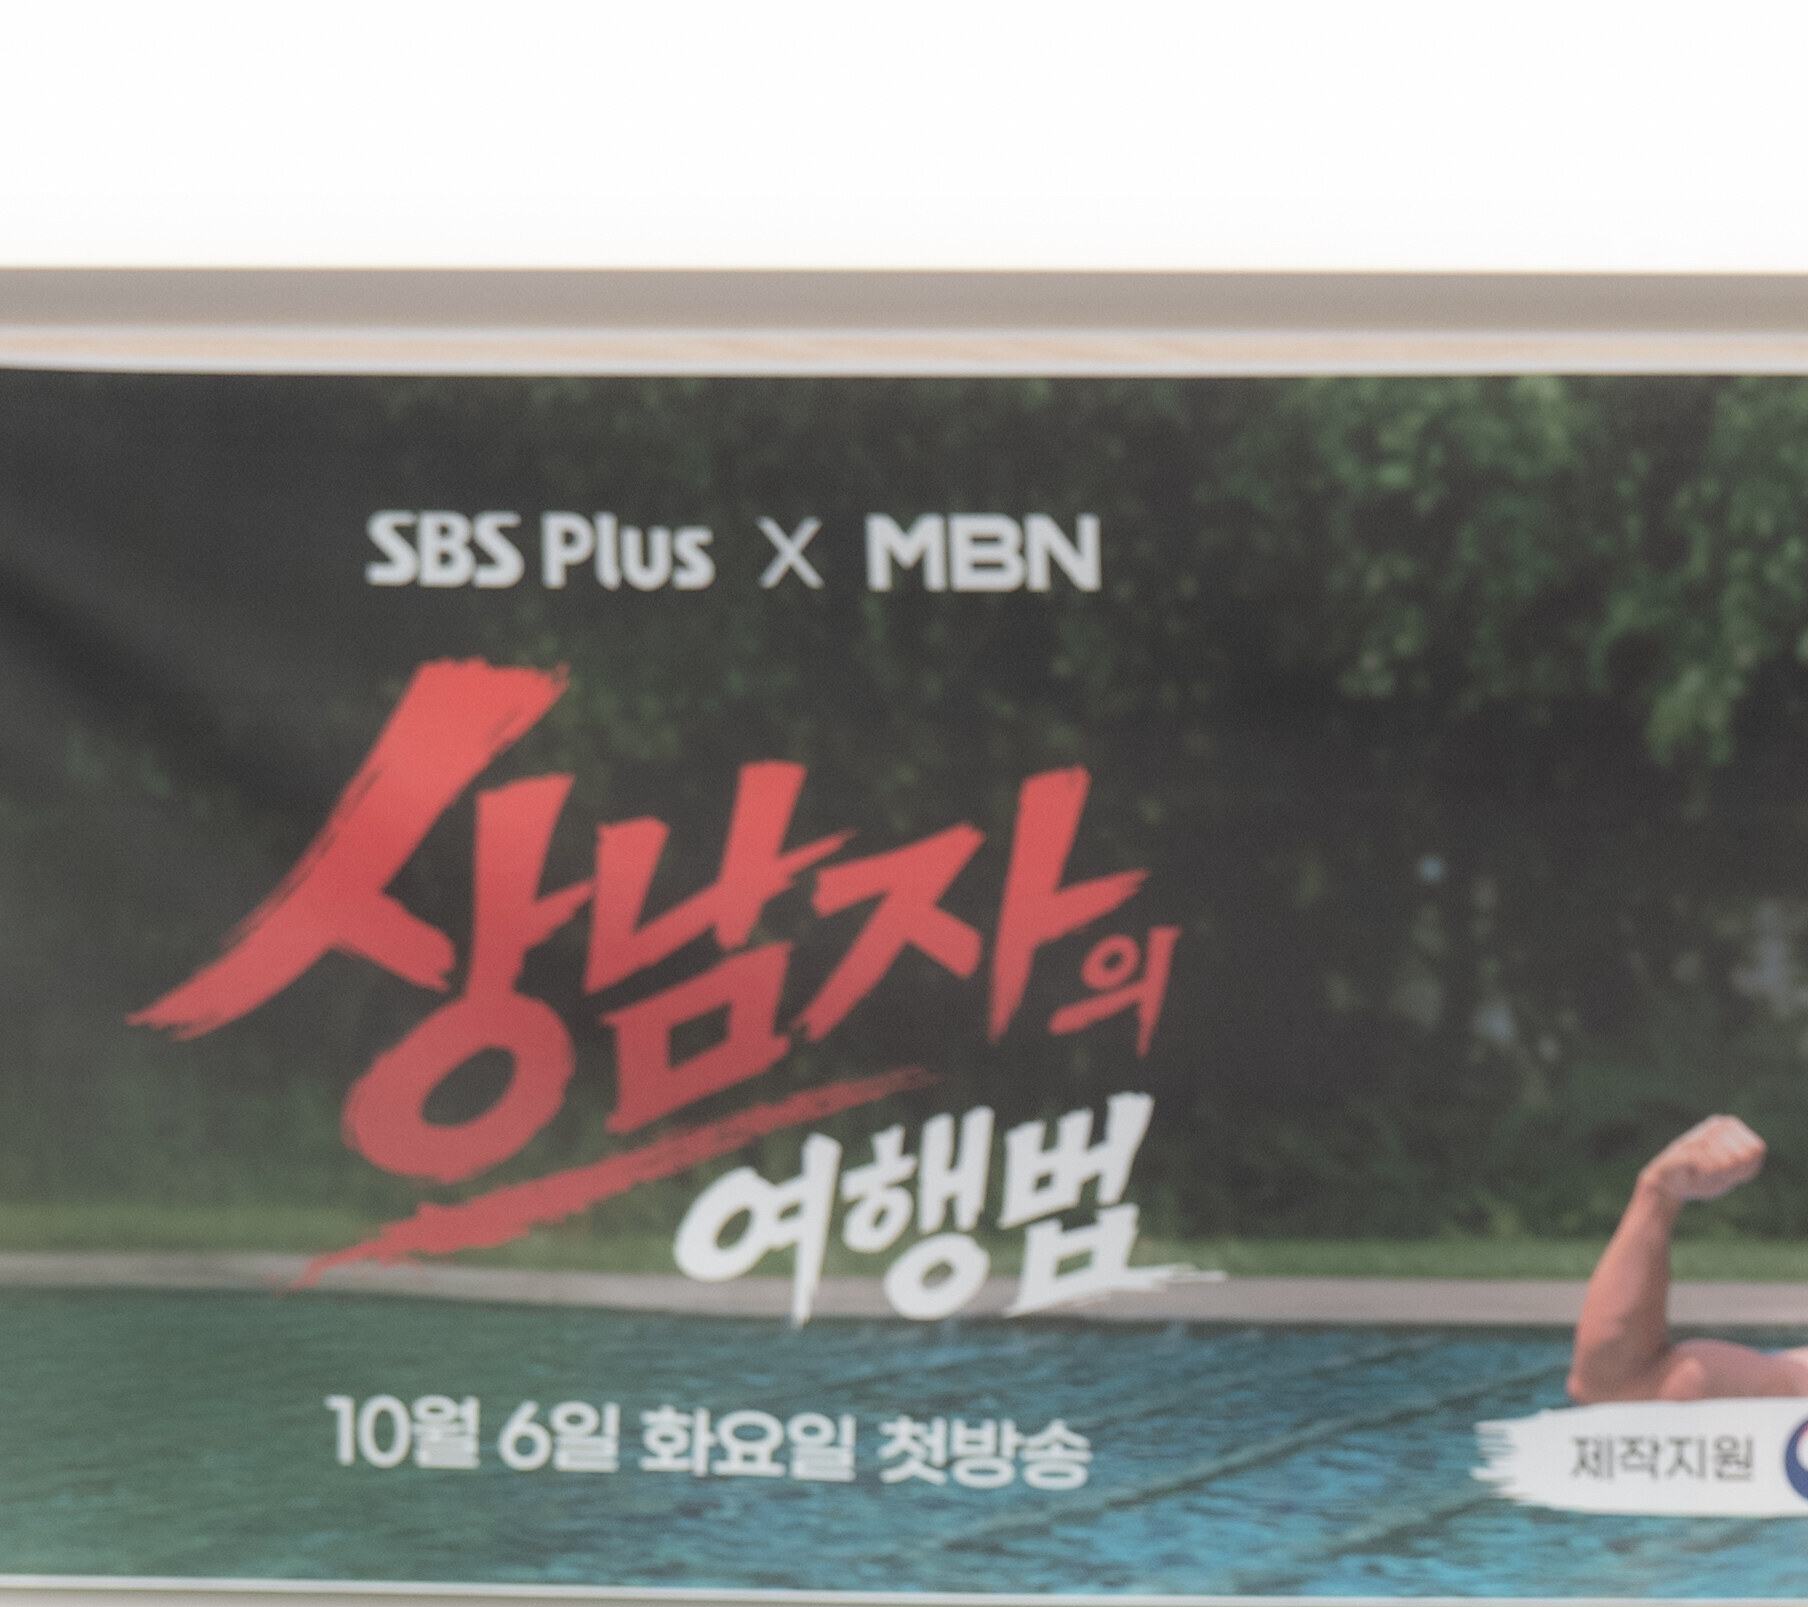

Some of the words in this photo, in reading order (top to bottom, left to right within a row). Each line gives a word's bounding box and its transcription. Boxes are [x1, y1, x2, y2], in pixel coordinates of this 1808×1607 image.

[365, 509, 524, 588] SBS
[541, 511, 715, 591] Plus
[865, 514, 1102, 592] MBN
[125, 656, 1184, 1185] 상남자의
[324, 1395, 481, 1472] 10월
[497, 1400, 622, 1476] 6일
[638, 1405, 857, 1483] 화요일
[878, 1415, 1093, 1492] 첫방송
[1570, 1433, 1755, 1483] 제작지원
